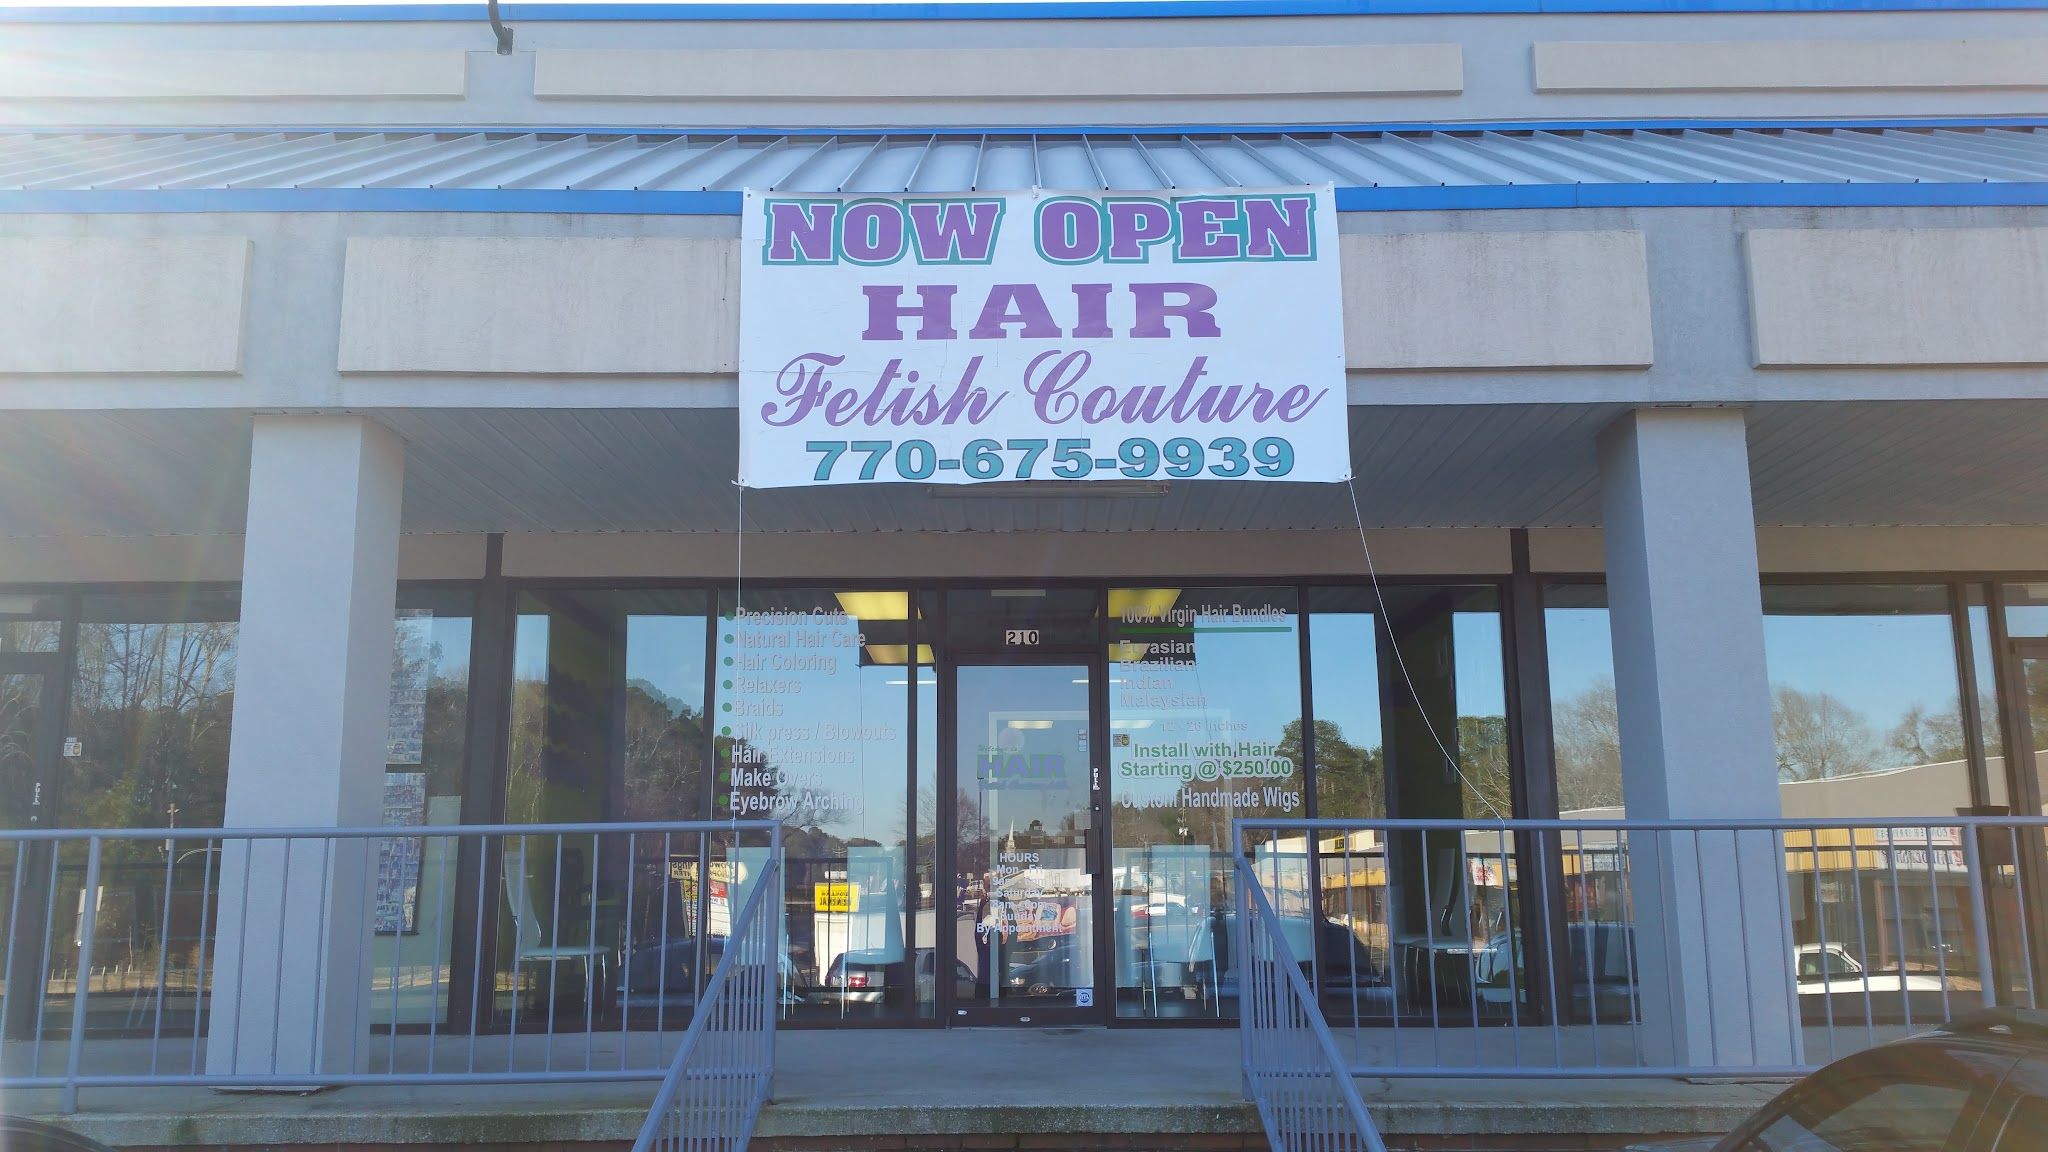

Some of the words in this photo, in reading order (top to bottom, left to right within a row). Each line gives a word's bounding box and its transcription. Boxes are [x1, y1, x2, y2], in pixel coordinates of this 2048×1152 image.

[762, 197, 1006, 266] NOW
[1034, 193, 1317, 266] OPEN
[862, 282, 1222, 341] HAIR
[761, 352, 1008, 427] Fetish
[1023, 349, 1330, 427] Couture
[806, 436, 1296, 481] 770-675-9939
[736, 606, 808, 626] Precision
[812, 606, 849, 626] Cuts
[1121, 605, 1154, 624] 100%
[1158, 605, 1198, 628] Virgin
[1201, 604, 1229, 623] Hair
[1232, 603, 1287, 623] Bundles
[736, 630, 791, 649] Natural
[796, 630, 827, 648] Hair
[831, 630, 866, 648] Care
[1007, 630, 1038, 645] 210
[736, 652, 767, 671] Hair
[771, 652, 837, 676] Coloring
[1119, 656, 1196, 673] Brazilian
[735, 675, 802, 694] Relaxers
[735, 698, 785, 717] Braids
[1119, 690, 1208, 710] Malaysian
[768, 727, 810, 745] press
[823, 721, 897, 741] Blowouts
[731, 744, 764, 763] Hair
[767, 745, 856, 764] Extensions
[1134, 742, 1189, 758] Install
[1194, 742, 1235, 758] with
[1238, 741, 1276, 758] Hair
[730, 767, 772, 787] Make
[776, 767, 823, 787] Overs
[1121, 761, 1193, 780] Starting
[1198, 760, 1217, 779] @
[1222, 758, 1291, 777] $250.00
[729, 792, 799, 815] Eyebrow
[802, 791, 864, 815] Arching
[1121, 788, 1177, 810] Custom
[1181, 787, 1260, 809] Handmade
[1263, 787, 1300, 812] Wigs
[999, 852, 1040, 863] HOURS
[996, 864, 1019, 874] Mon
[976, 924, 990, 935] By
[994, 923, 1063, 935] Appointment
